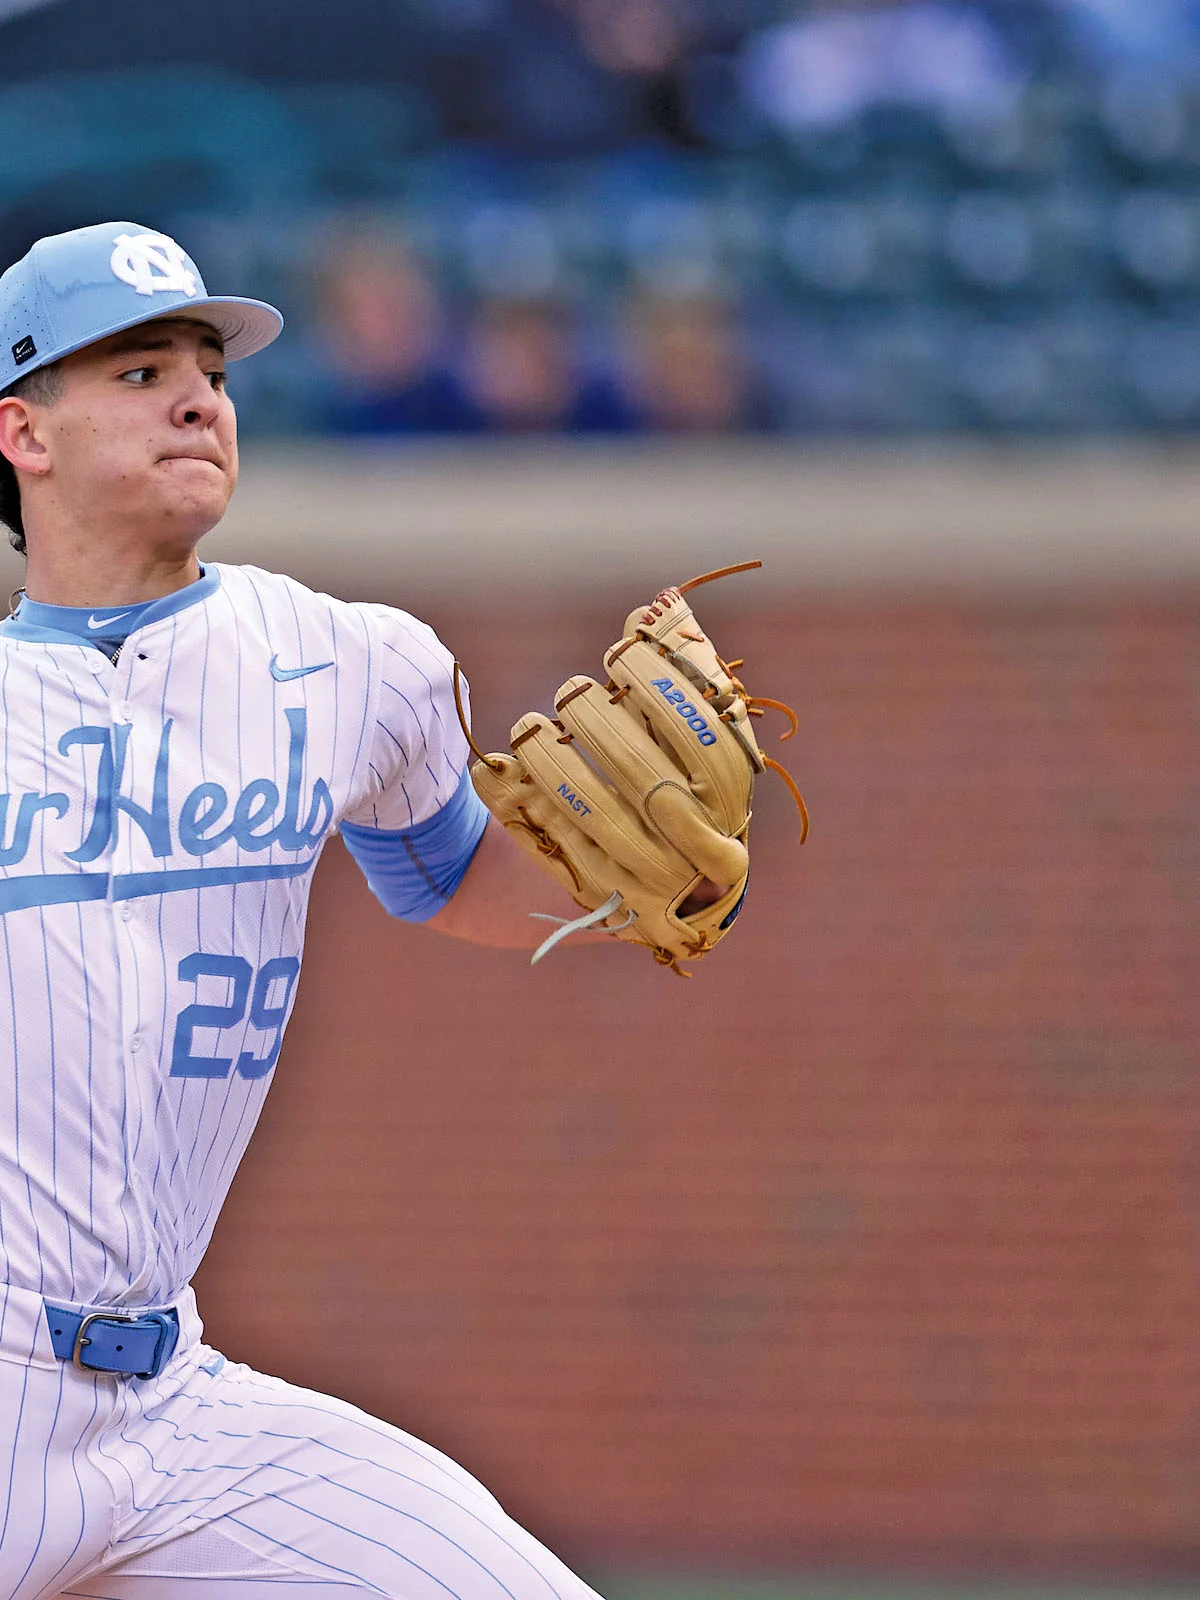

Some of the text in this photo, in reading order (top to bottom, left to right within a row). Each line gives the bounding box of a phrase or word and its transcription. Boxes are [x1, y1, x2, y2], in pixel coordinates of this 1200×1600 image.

[650, 677, 717, 746] A2000
[57, 707, 334, 863] Heels
[557, 783, 592, 817] NAST
[168, 952, 300, 1080] 29
